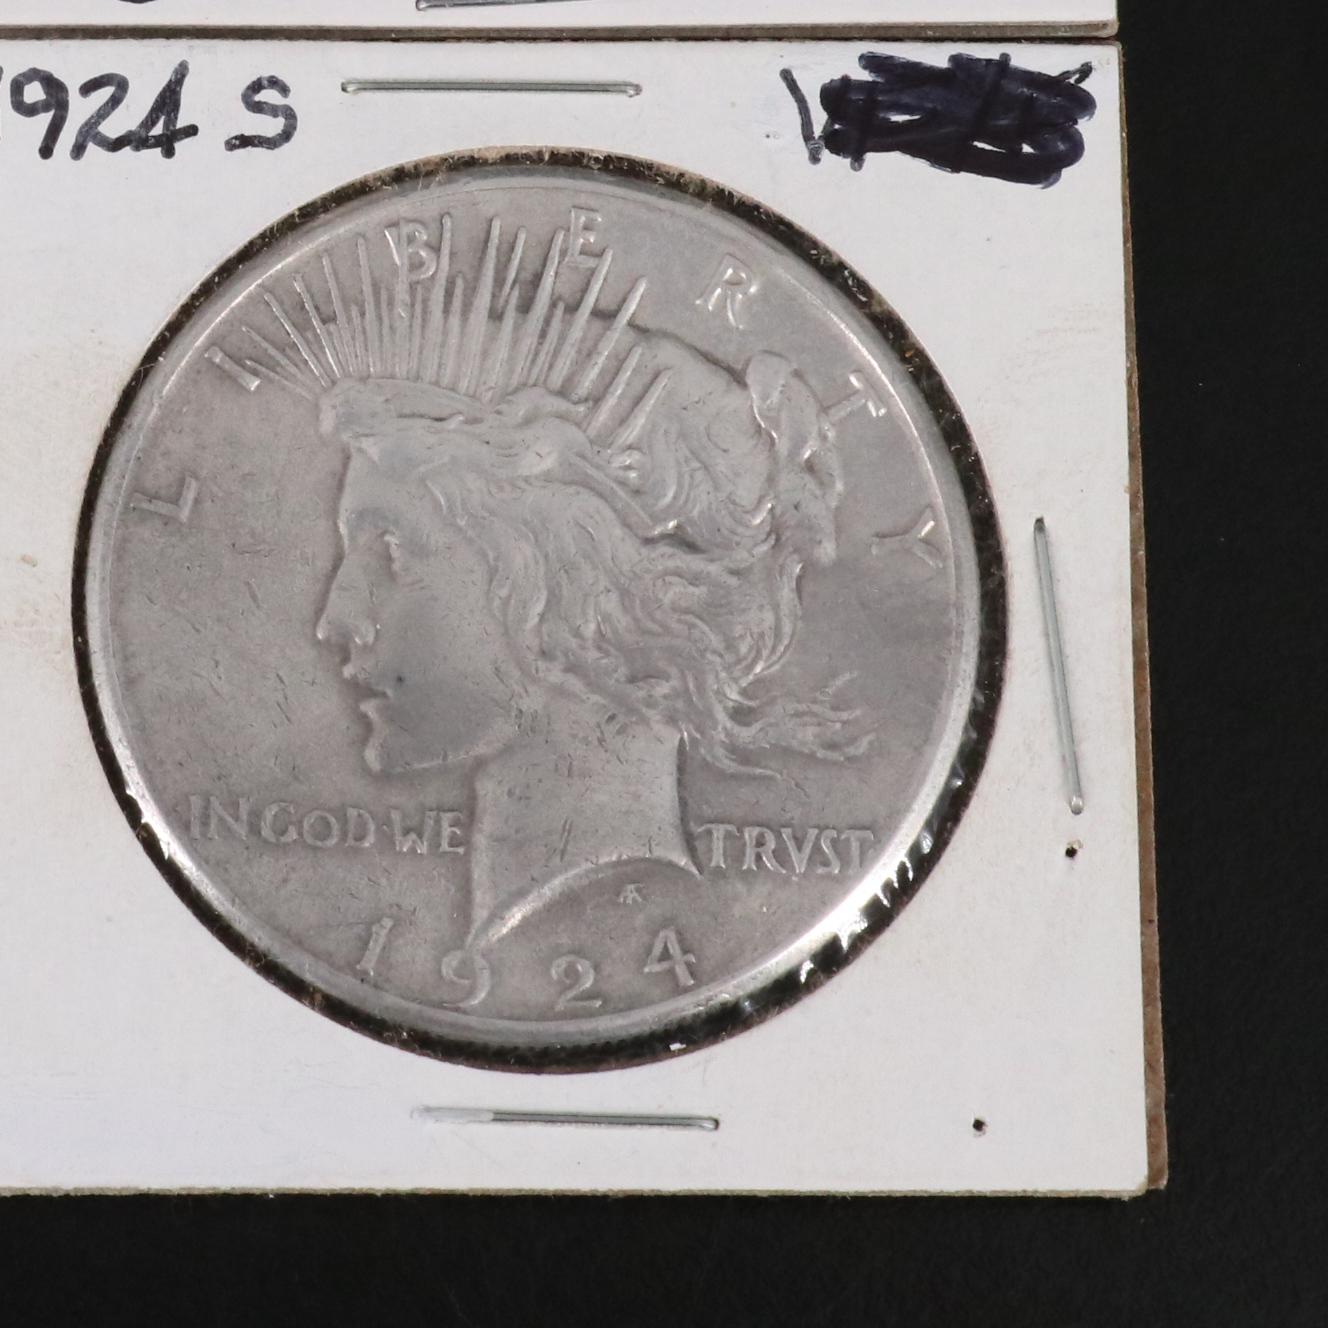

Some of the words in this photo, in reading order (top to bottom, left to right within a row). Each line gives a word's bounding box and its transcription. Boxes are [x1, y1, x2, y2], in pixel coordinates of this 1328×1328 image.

[224, 74, 299, 151] S
[187, 794, 253, 841] IN
[260, 801, 375, 849] GOD
[384, 809, 468, 855] WE
[696, 822, 874, 874] TRVST
[356, 915, 697, 1010] 1924
